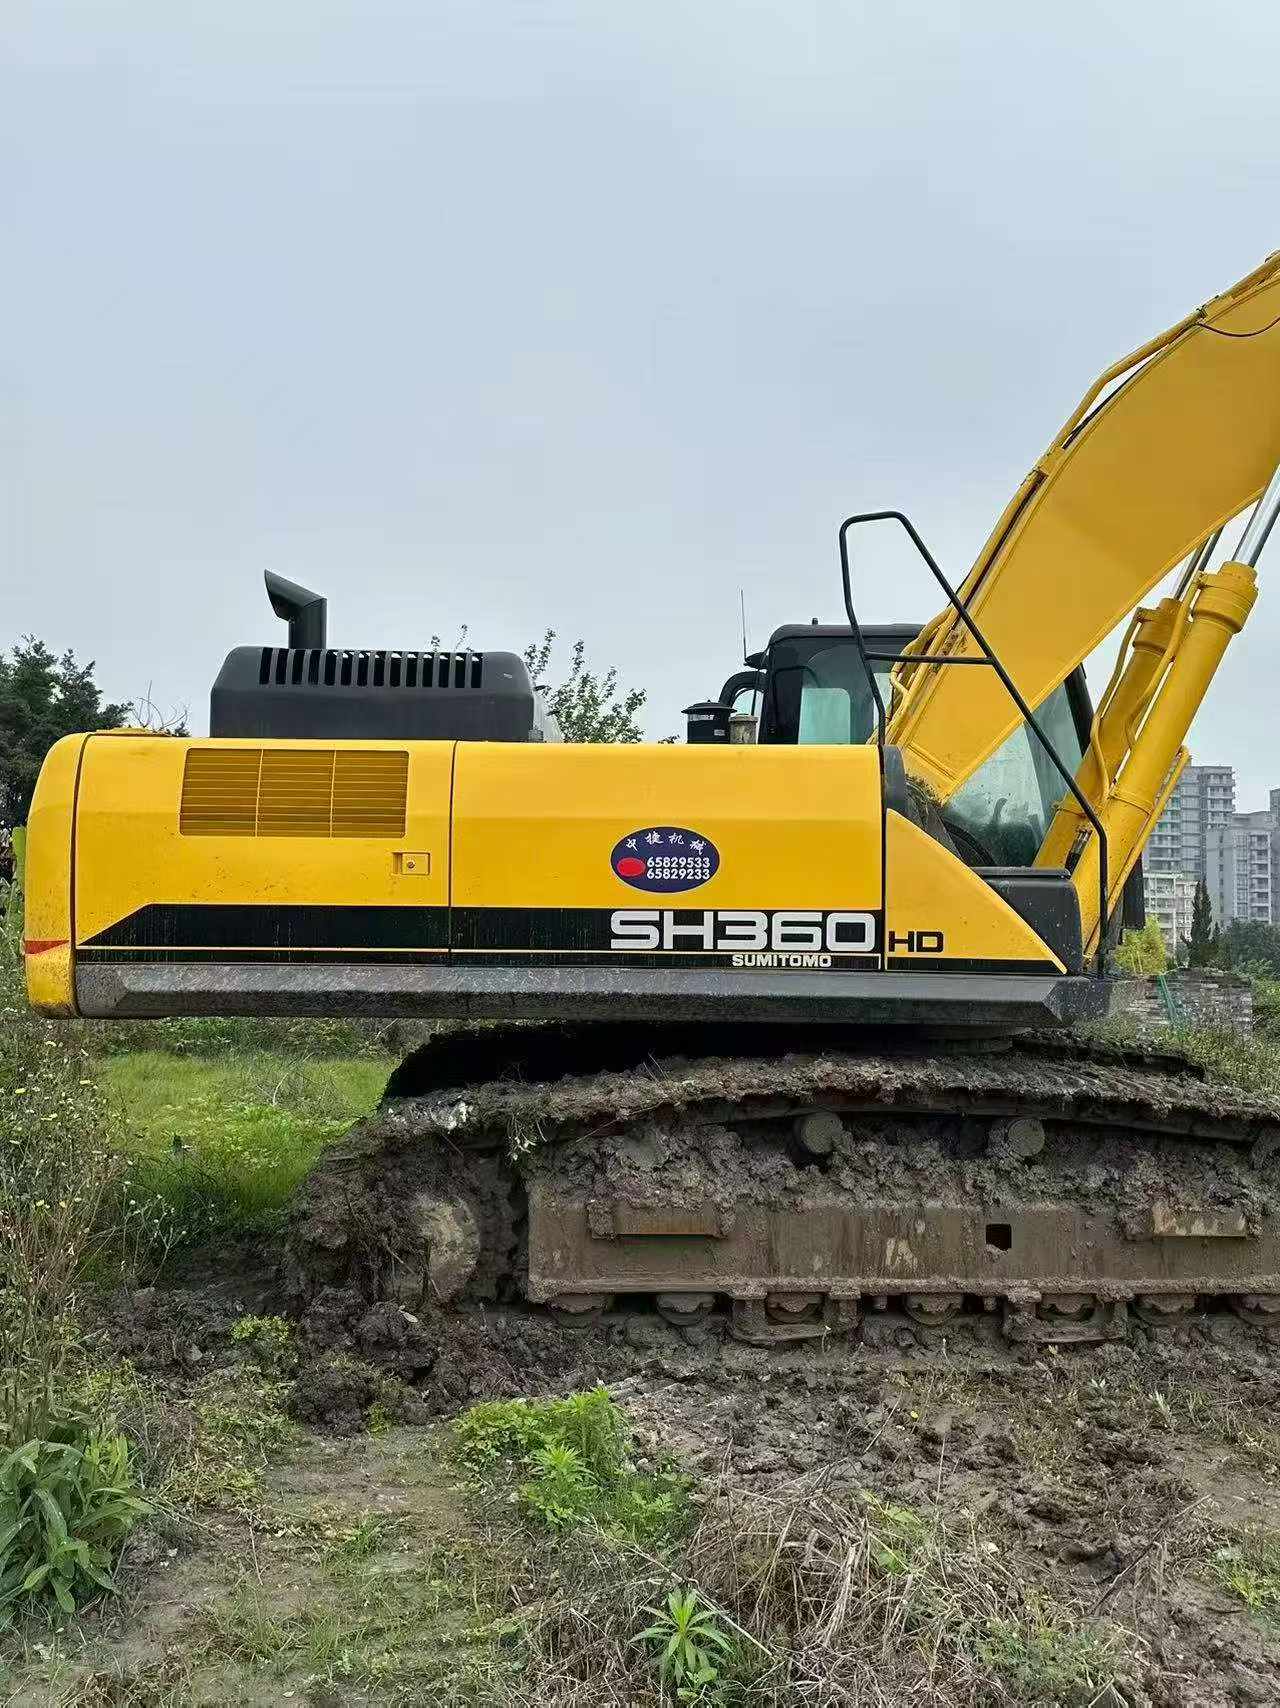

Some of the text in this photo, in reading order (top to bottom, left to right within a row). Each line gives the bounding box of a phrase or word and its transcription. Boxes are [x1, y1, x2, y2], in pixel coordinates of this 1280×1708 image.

[646, 856, 711, 868] 65829533
[646, 868, 711, 880] 65829233
[610, 910, 875, 952] SH360
[888, 930, 944, 953] HD
[731, 953, 832, 968] SUMITOMO
